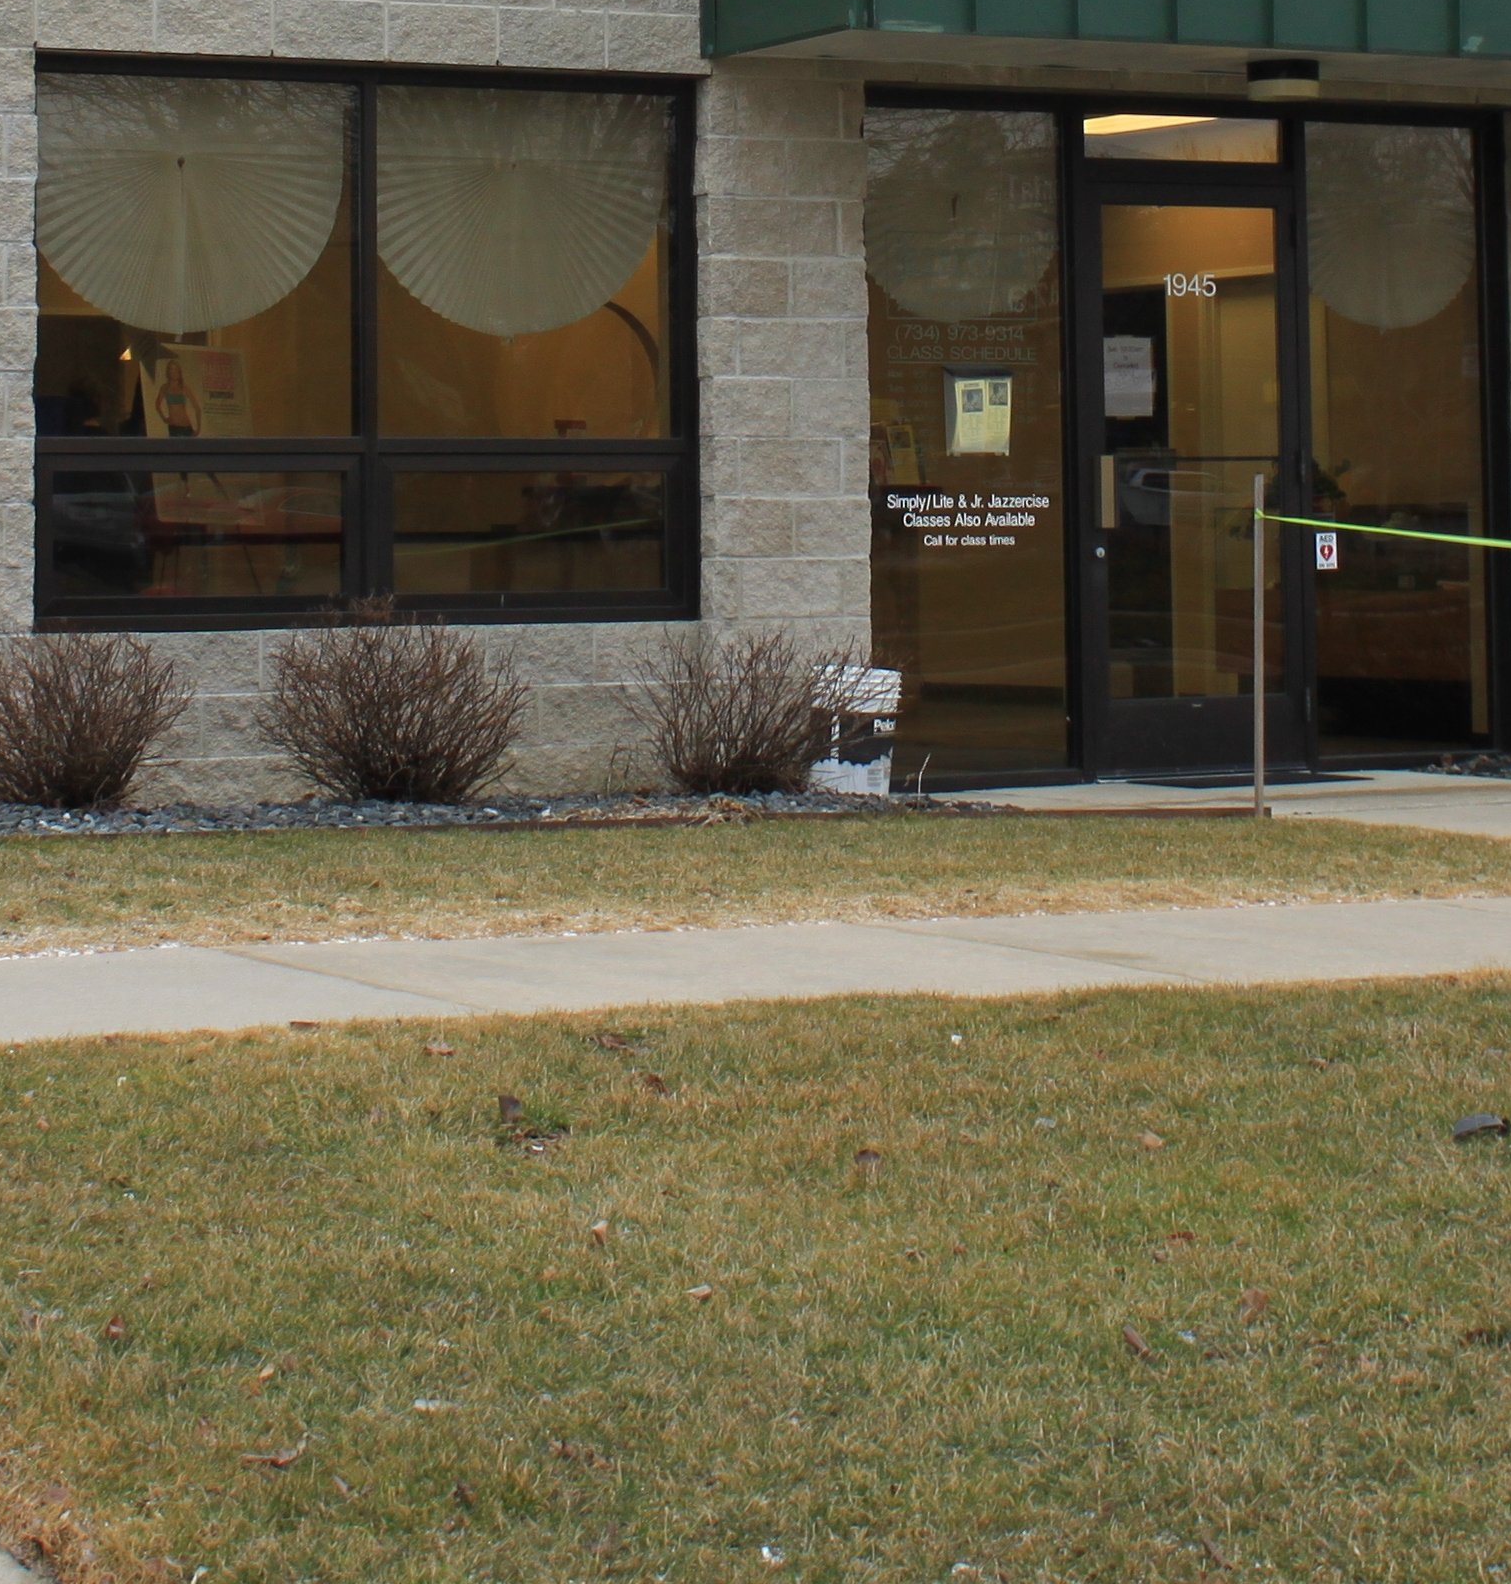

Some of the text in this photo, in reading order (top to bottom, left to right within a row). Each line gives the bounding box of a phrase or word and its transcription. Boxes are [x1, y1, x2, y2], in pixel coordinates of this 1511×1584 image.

[1163, 273, 1217, 297] 1945
[894, 323, 1025, 343] (734) 973-9314
[887, 345, 1037, 362] CLASS SCHEDULE
[957, 493, 968, 509] &
[970, 493, 985, 509] Jr.
[987, 493, 1050, 509] Jazzercise
[903, 512, 1036, 528] Classes Also Available
[923, 533, 1016, 546] Call for class times
